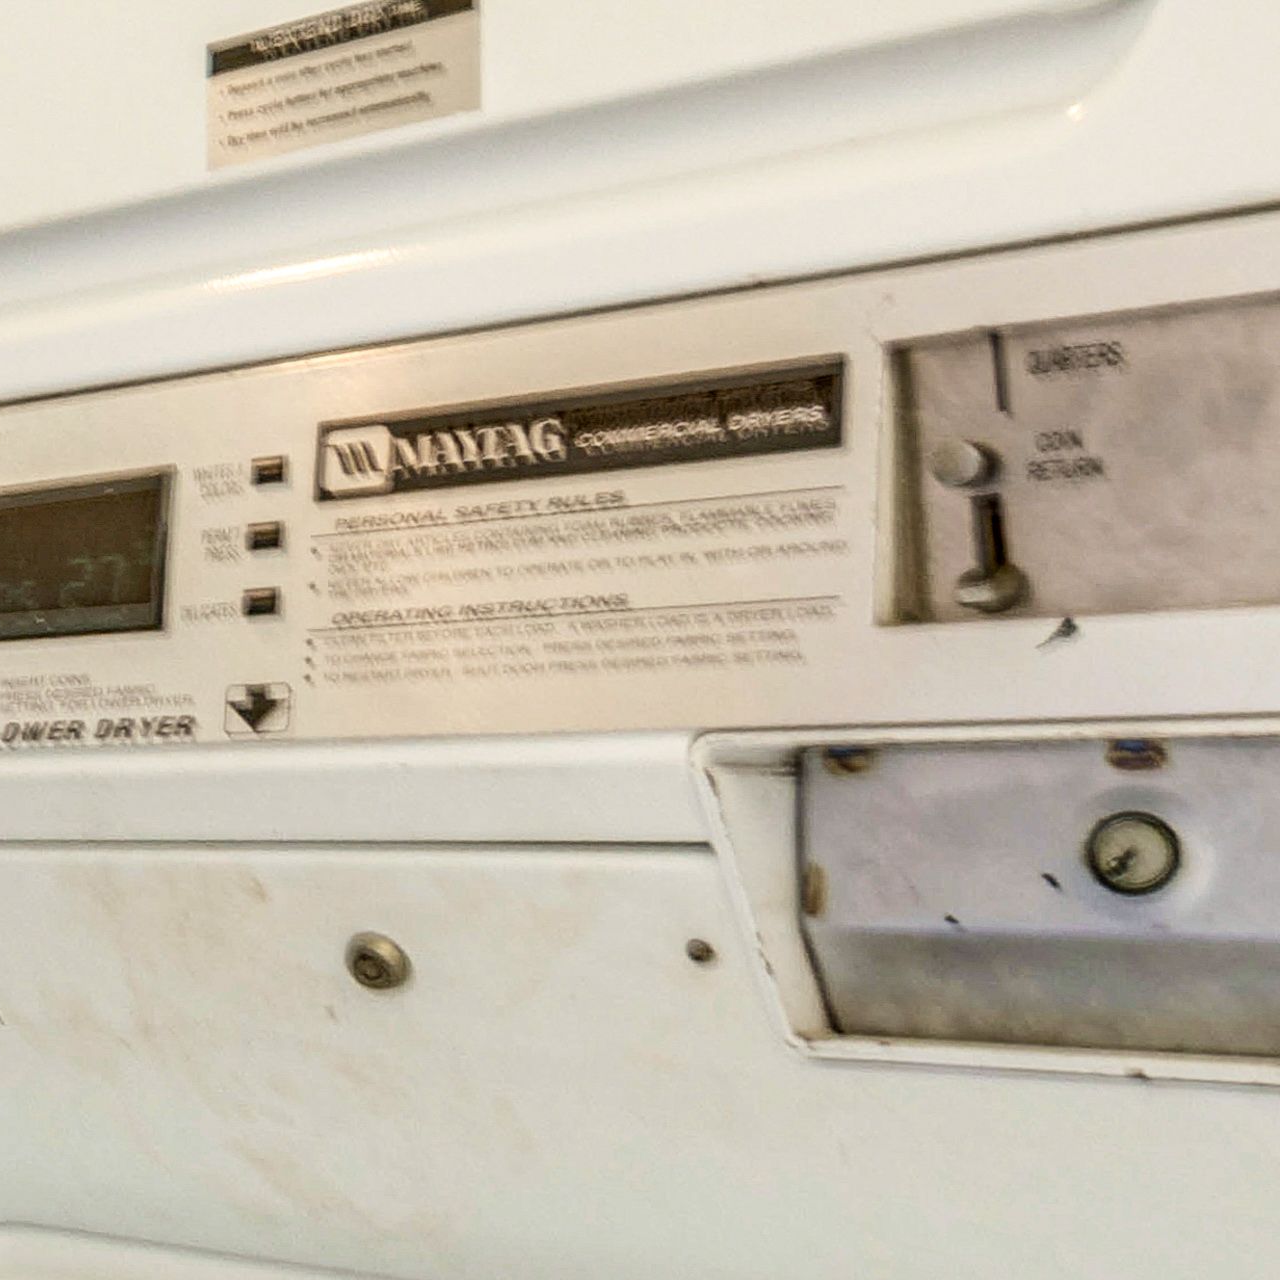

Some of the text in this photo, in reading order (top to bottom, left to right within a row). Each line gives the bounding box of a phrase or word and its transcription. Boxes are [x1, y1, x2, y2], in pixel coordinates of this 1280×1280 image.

[392, 404, 826, 476] MAYTAG COMMERCIAL DRYERS
[335, 490, 626, 530] PERSONAL SAFETY RULES
[331, 593, 628, 626] OPERATING INSTRUCTIONS
[94, 714, 197, 738] DRYER
